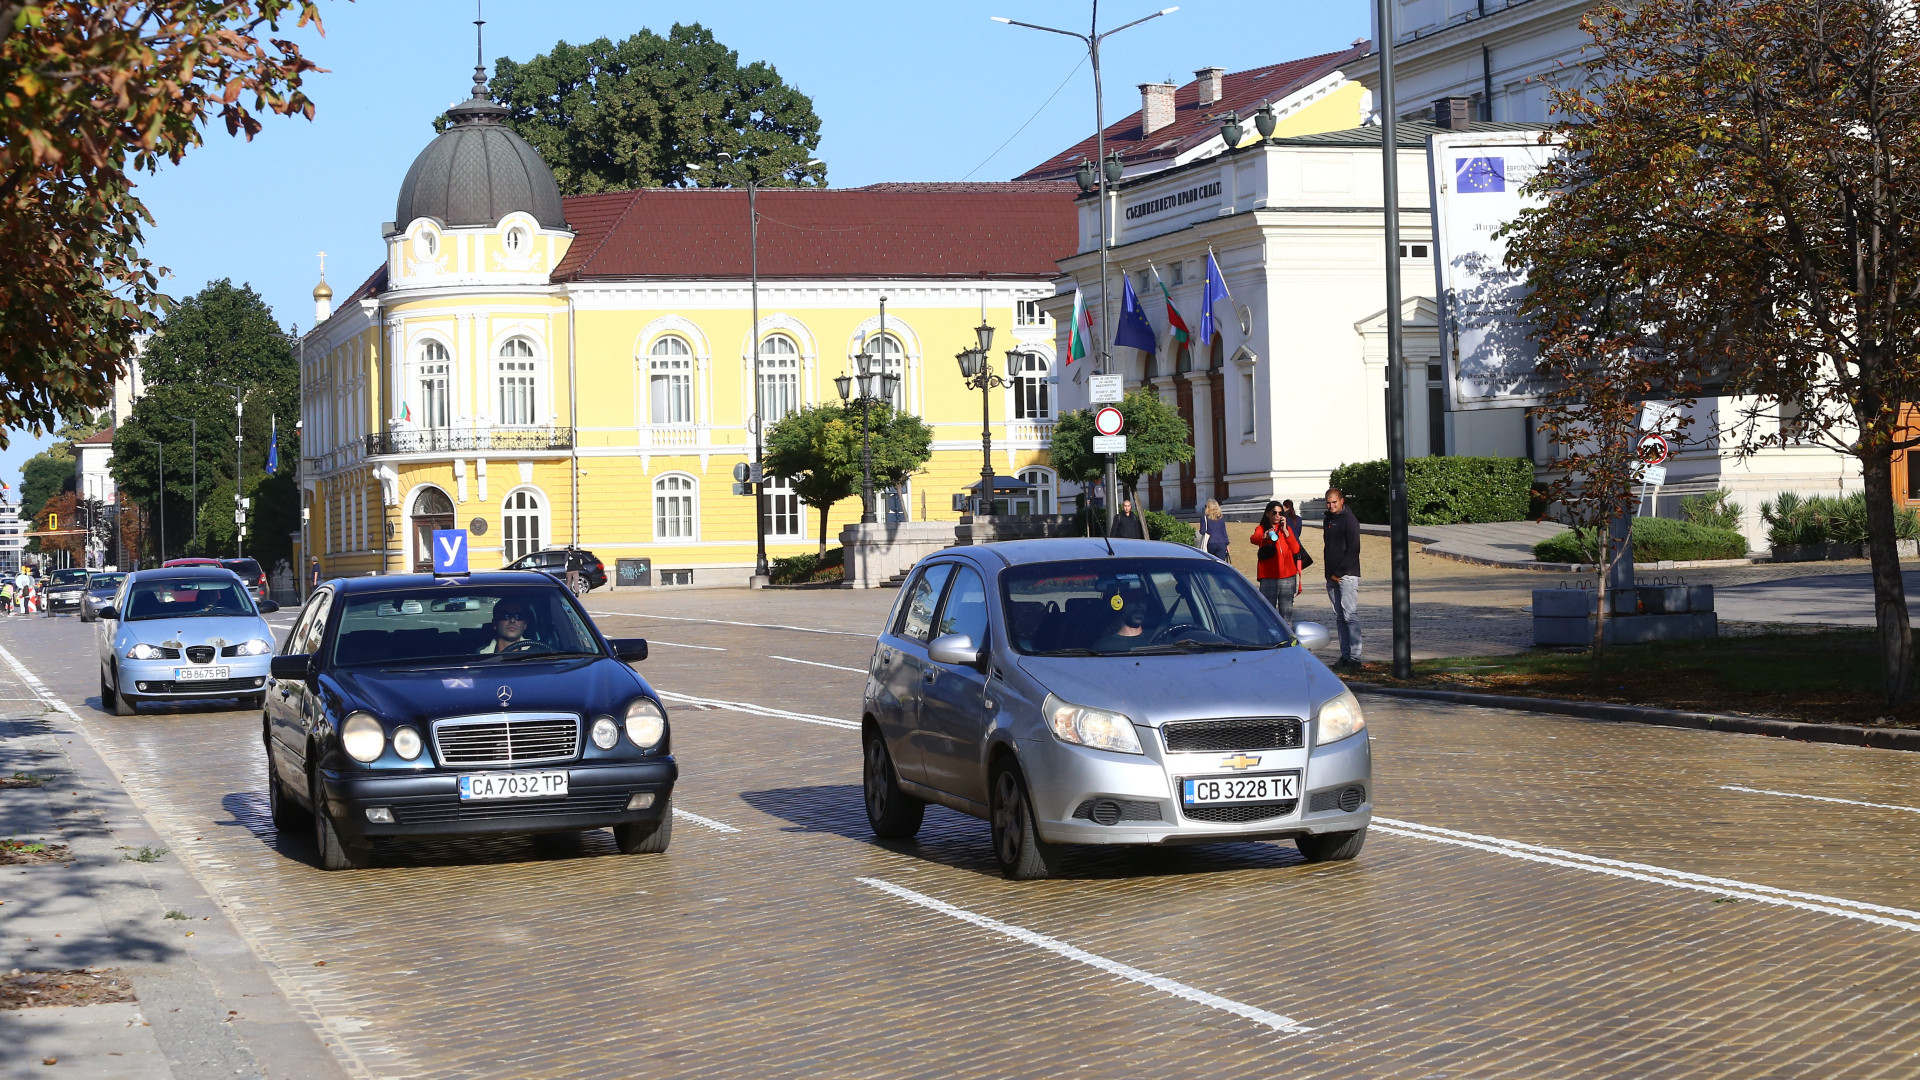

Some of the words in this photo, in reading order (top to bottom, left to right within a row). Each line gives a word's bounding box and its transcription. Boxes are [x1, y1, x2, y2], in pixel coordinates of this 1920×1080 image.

[472, 779, 494, 796] CA
[498, 776, 539, 795] 7032
[542, 775, 564, 792] TP
[1197, 782, 1221, 801] CB
[1224, 780, 1267, 799] 3228
[1270, 778, 1293, 797] TK
